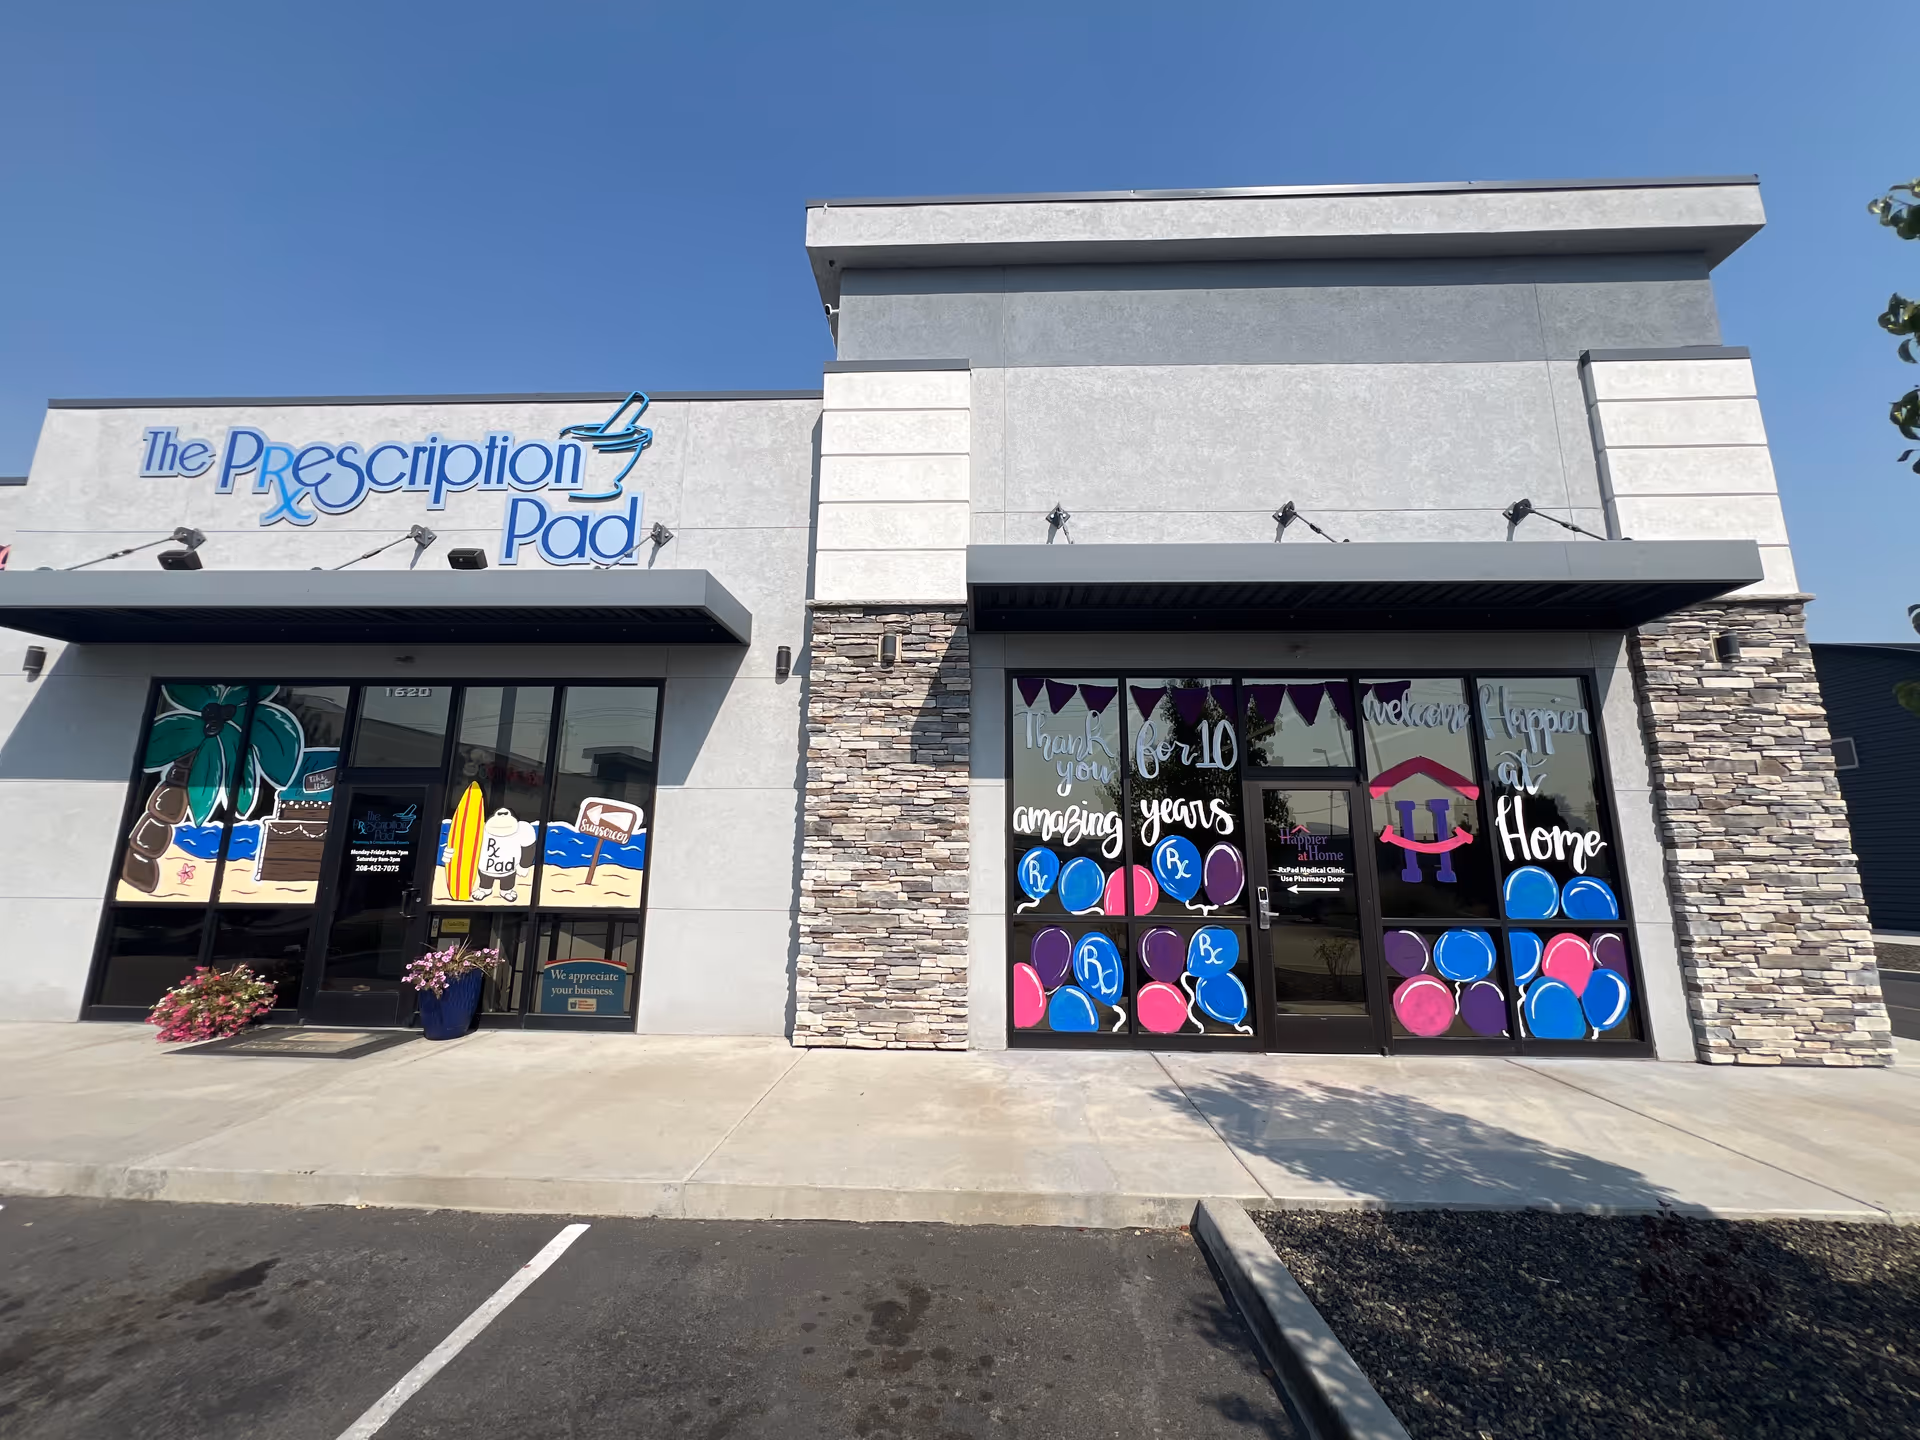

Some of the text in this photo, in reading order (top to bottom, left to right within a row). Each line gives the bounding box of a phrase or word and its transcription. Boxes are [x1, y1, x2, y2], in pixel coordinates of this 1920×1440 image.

[141, 427, 215, 477] The
[499, 493, 641, 565] Pad
[385, 687, 432, 698] 1620
[1014, 709, 1115, 762] Thank
[1479, 684, 1592, 755] Happier
[1136, 719, 1238, 779] for 10
[1056, 758, 1117, 797] you
[1496, 749, 1548, 795] at
[580, 818, 629, 844] Sunscreen
[1013, 798, 1234, 859] amazing years
[1278, 828, 1327, 851] Happier
[1495, 795, 1608, 874] Home
[487, 838, 501, 858] Rx
[1165, 847, 1192, 880] Rx
[1297, 844, 1344, 861] at Home
[355, 864, 399, 872] 208-452-7075
[486, 856, 516, 873] Pad
[1028, 859, 1051, 893] Rx
[1294, 875, 1327, 884] Pharmacy
[1327, 875, 1345, 883] Door
[1300, 866, 1326, 874] Medical
[1326, 866, 1346, 874] Clinic
[1198, 933, 1224, 965] Rx
[551, 969, 619, 984] We appreciate
[1083, 945, 1114, 995] Rx
[550, 985, 615, 998] your business.
